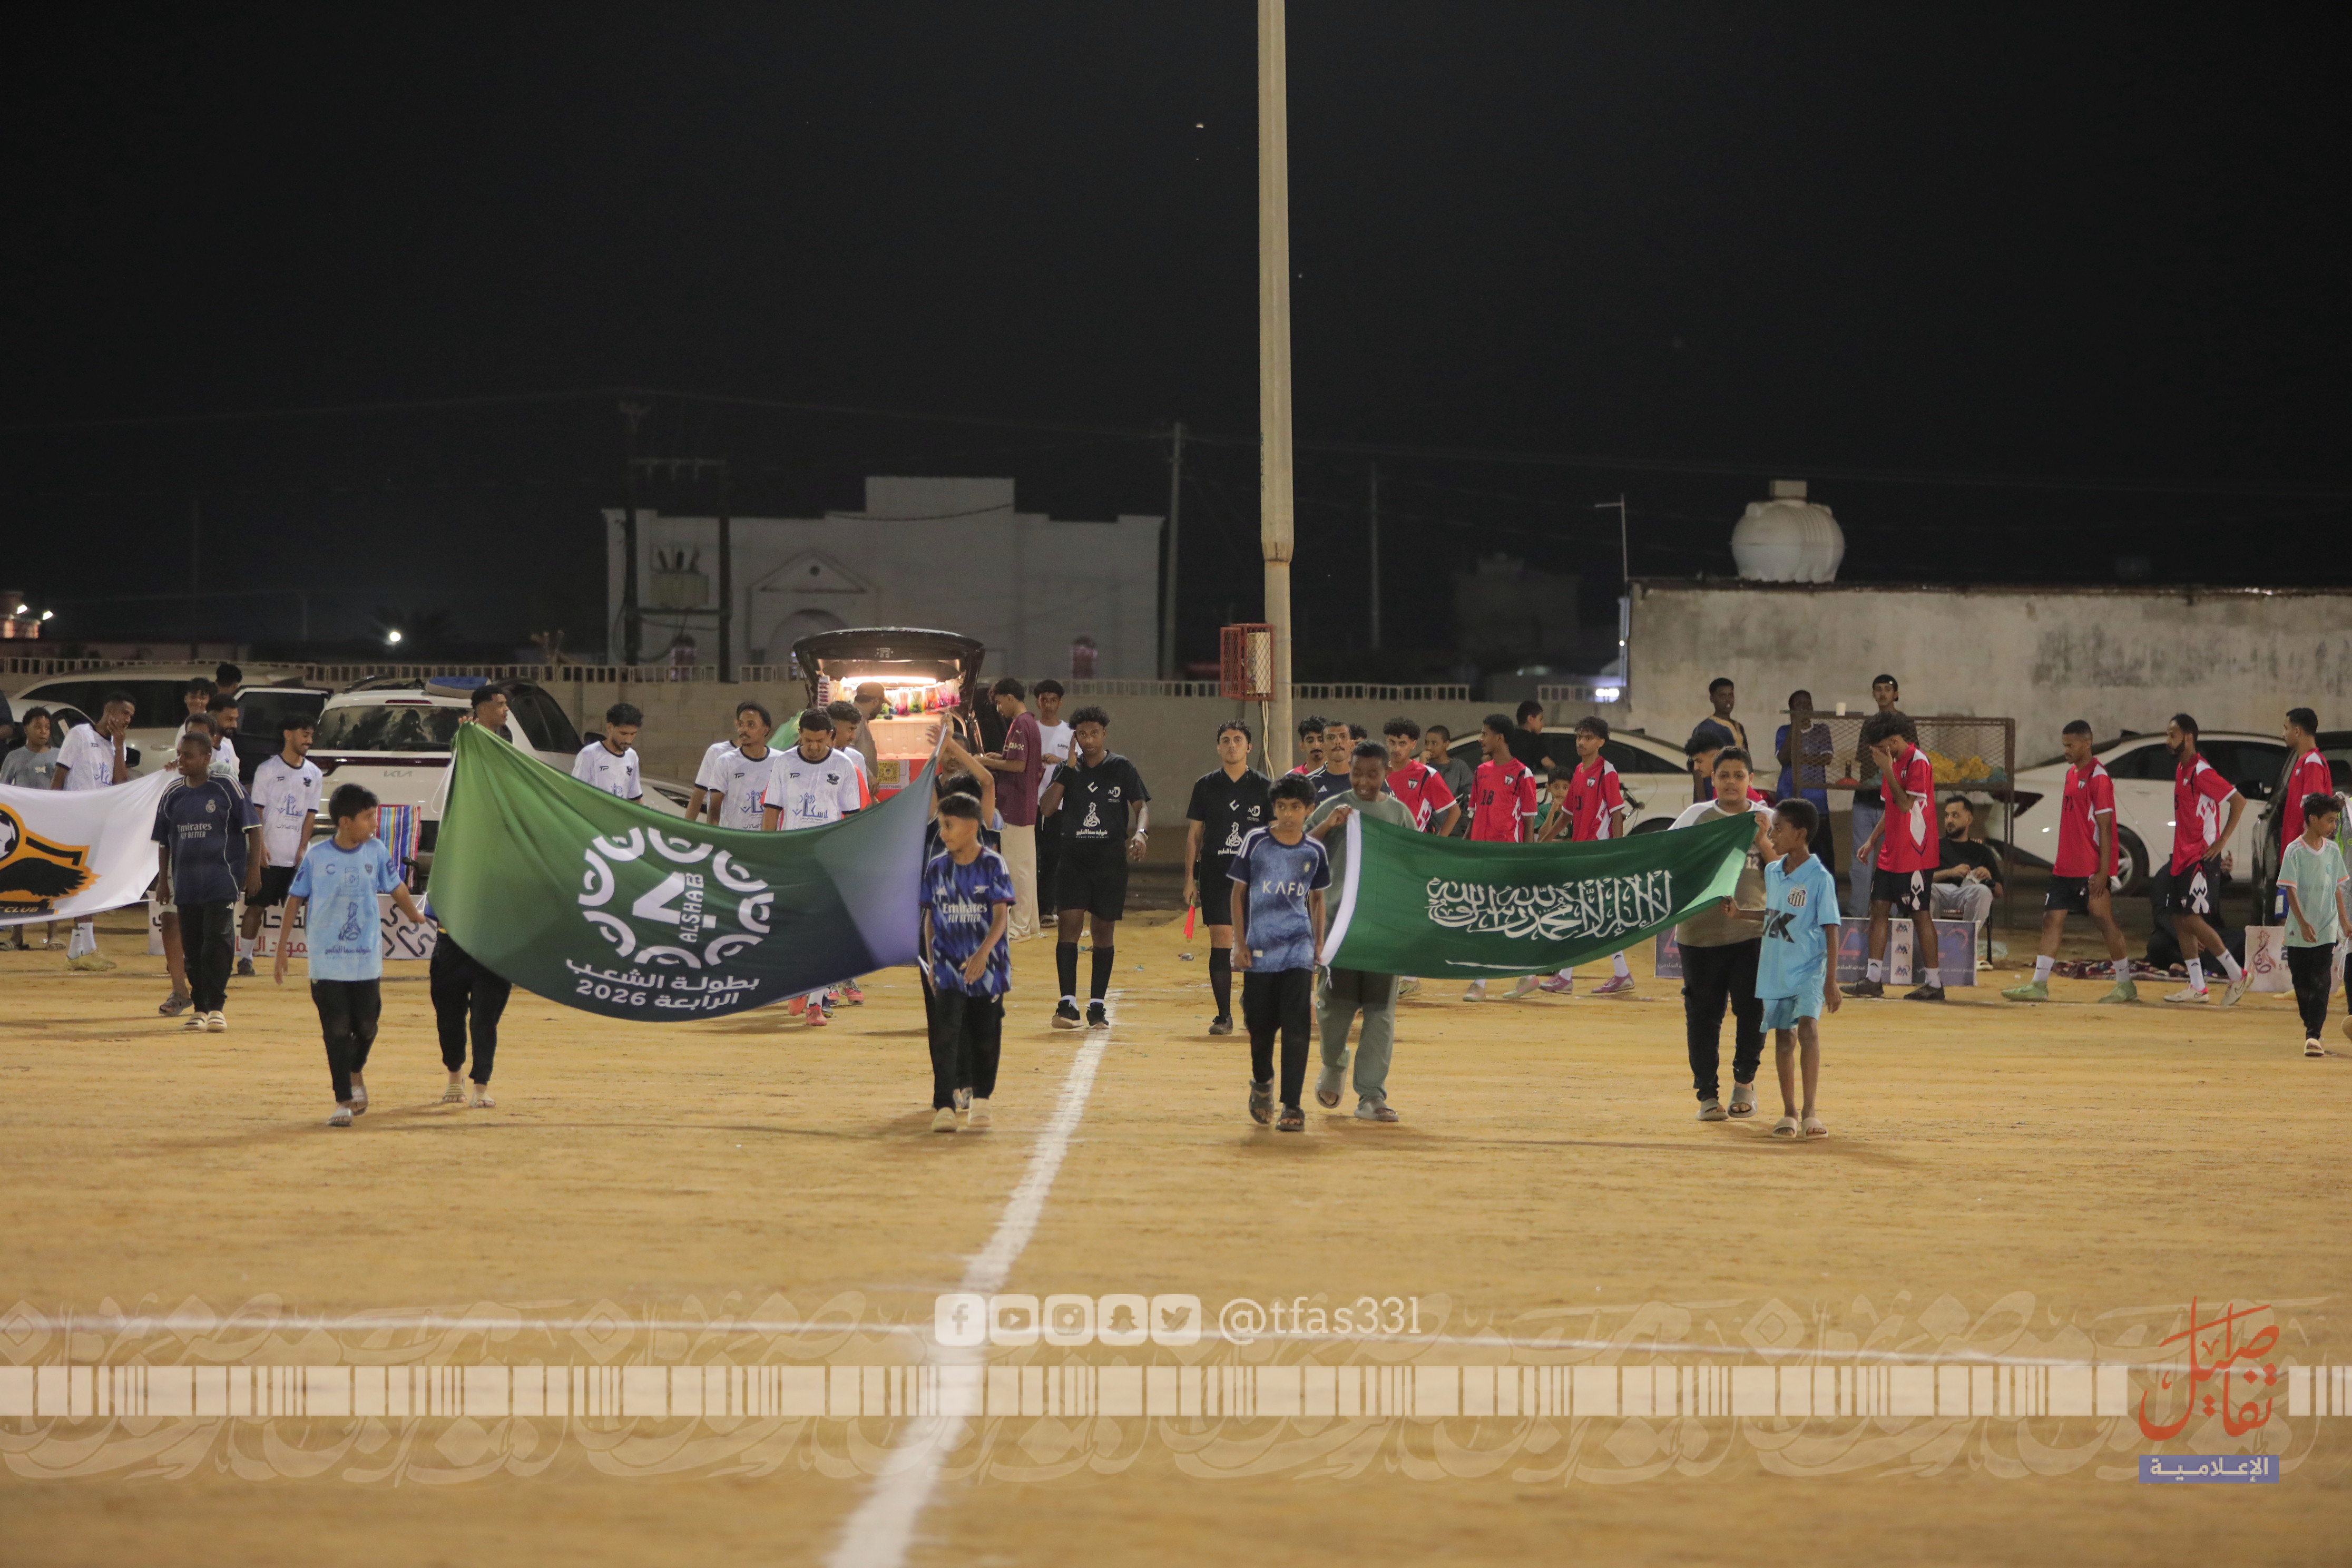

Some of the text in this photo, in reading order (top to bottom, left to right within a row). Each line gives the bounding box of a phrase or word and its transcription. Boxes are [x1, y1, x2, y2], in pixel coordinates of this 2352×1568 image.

[1481, 789, 1494, 805] 18
[679, 872, 704, 943] ALSHAB
[942, 903, 988, 914] Emirates
[948, 914, 981, 923] FLY BETTER
[566, 958, 760, 993] بطولة الشعب
[576, 979, 740, 1010] الرابعة 2026
